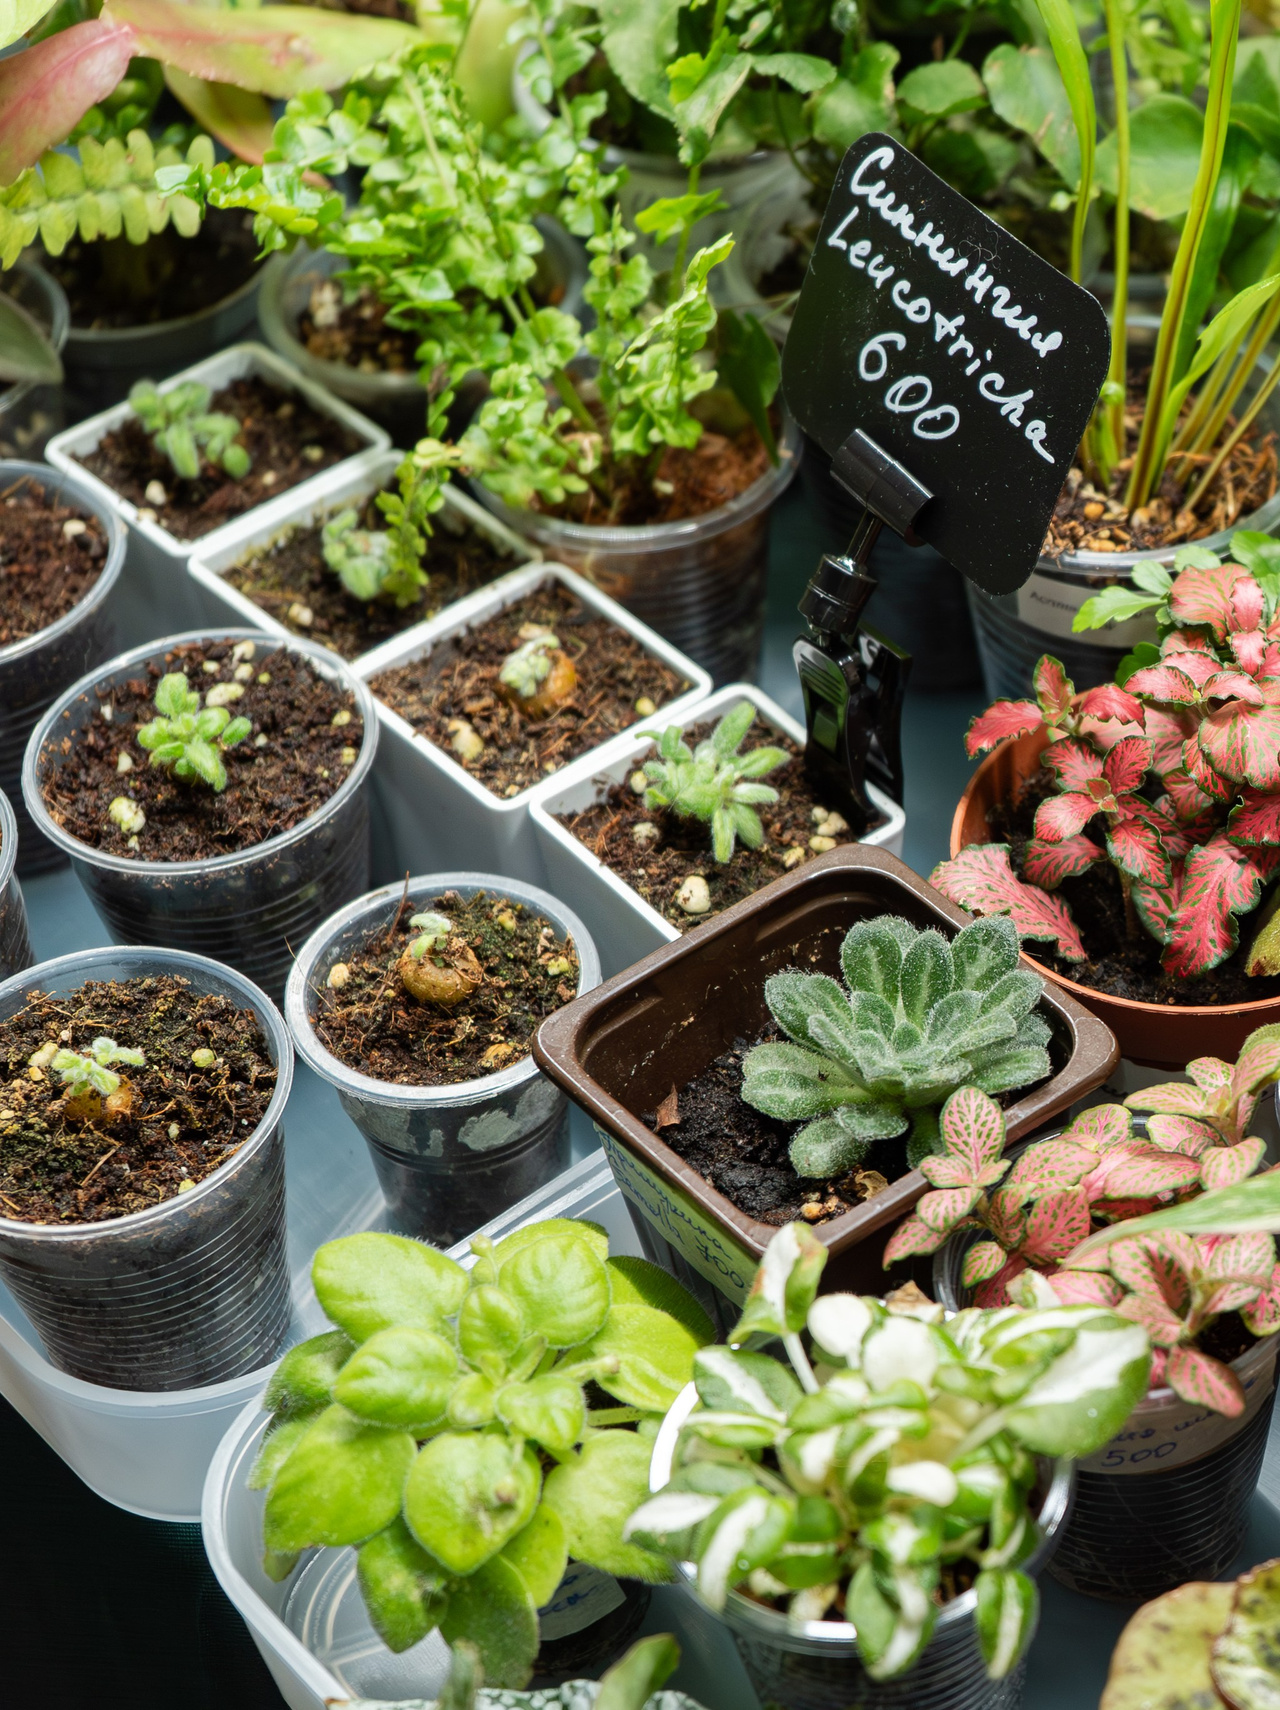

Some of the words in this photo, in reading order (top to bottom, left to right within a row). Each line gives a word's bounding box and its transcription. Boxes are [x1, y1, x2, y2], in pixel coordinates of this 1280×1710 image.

[858, 332, 961, 440] 600
[694, 1235, 746, 1289] 700
[1101, 1441, 1178, 1467] 500
